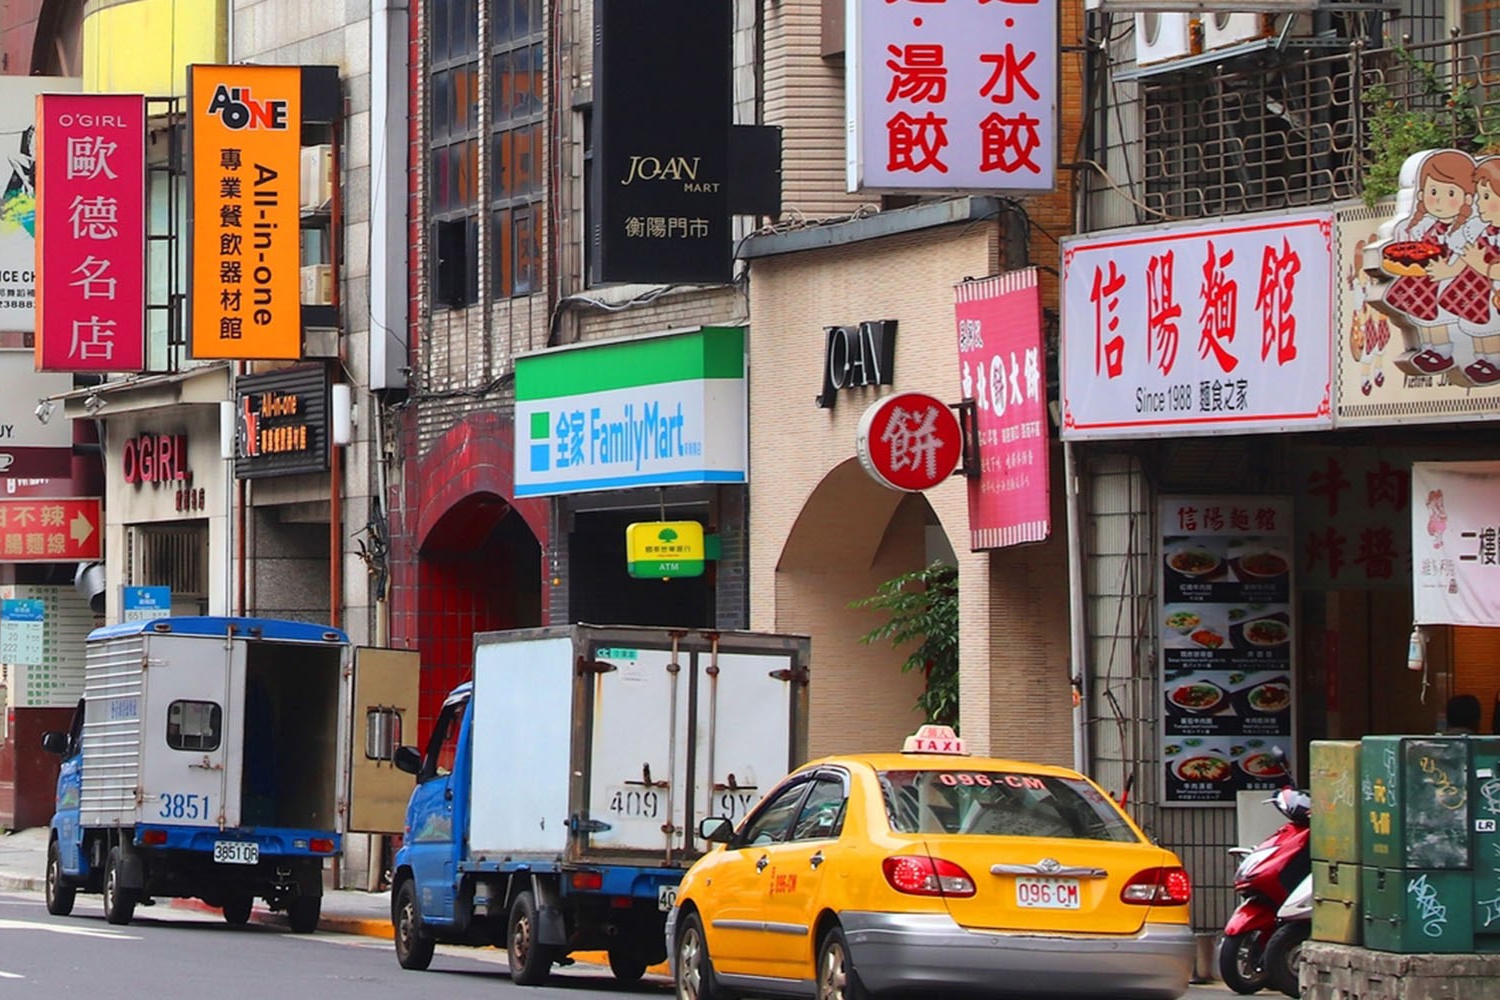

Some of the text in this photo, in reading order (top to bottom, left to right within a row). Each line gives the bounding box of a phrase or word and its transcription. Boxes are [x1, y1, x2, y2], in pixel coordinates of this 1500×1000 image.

[59, 113, 128, 129] O'GIRL
[621, 156, 701, 185] JOAN
[684, 183, 720, 193] MART
[625, 216, 709, 239] 衡陽門市
[66, 136, 119, 360] 歐德名店
[219, 148, 243, 340] 專業餐飲器材館
[253, 162, 279, 327] All-in-one
[1090, 235, 1302, 380] 信陽麵館
[1135, 379, 1249, 414] Since 1988 麵食之家
[556, 401, 685, 471] 全家 FamilyMart
[881, 405, 945, 480] 餅
[122, 434, 187, 485] O'GIRL
[1177, 506, 1277, 531] 信陽麵館
[658, 563, 680, 571] ATM
[915, 739, 961, 752] TAXI
[939, 773, 1047, 790] 096-CM
[159, 793, 209, 819] 3851
[610, 790, 658, 818] 409
[1477, 820, 1494, 831] LR
